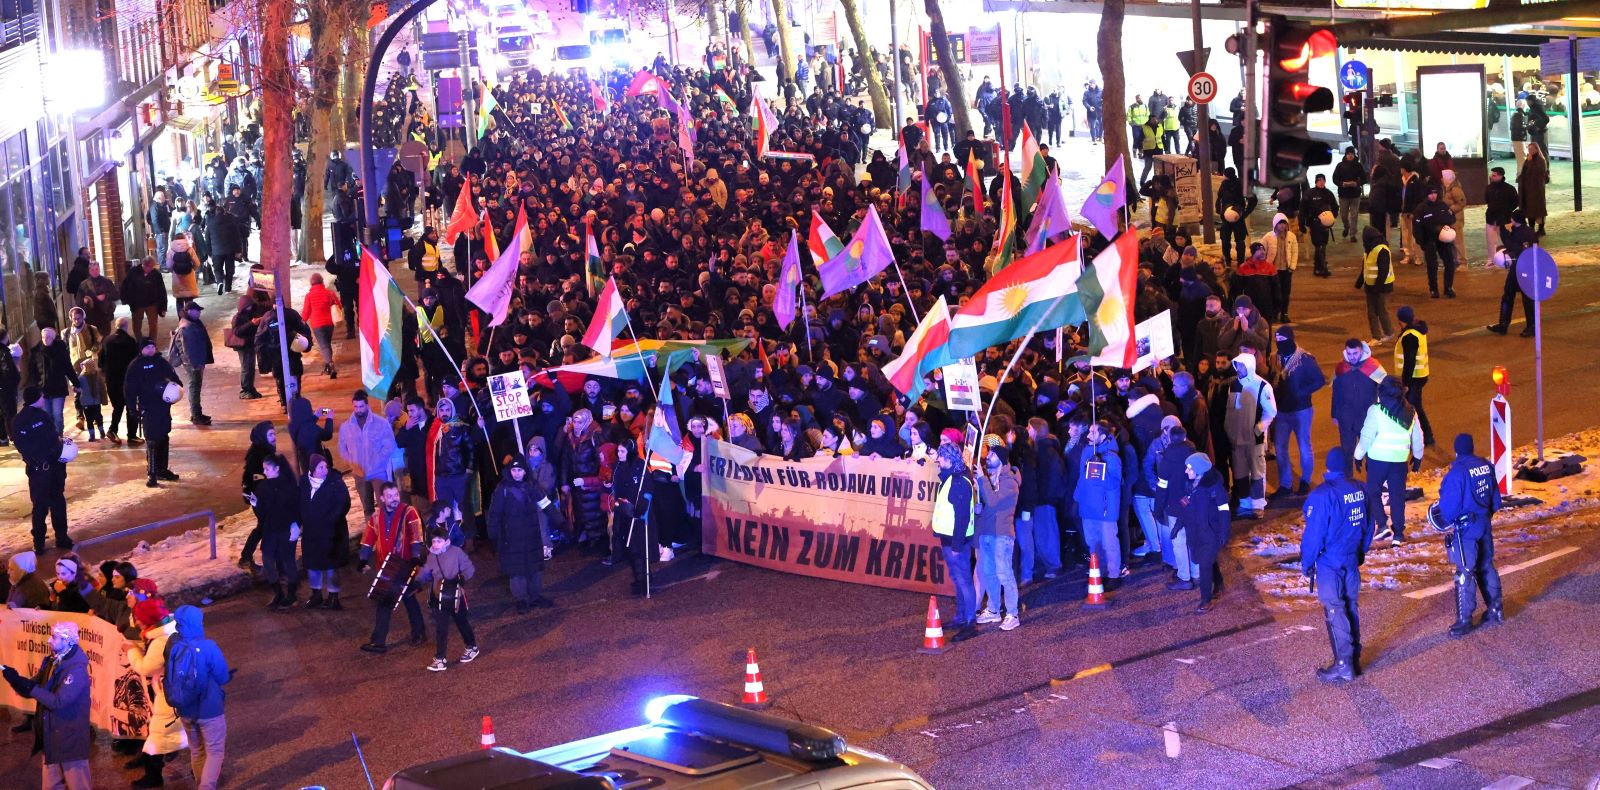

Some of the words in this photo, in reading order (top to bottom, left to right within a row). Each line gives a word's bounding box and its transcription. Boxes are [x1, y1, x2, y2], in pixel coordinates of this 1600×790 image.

[1194, 81, 1211, 95] 30
[496, 392, 521, 406] STOP
[709, 455, 774, 485] FRIEDEN
[778, 466, 811, 489] FÜR
[815, 471, 876, 496] ROJAVA
[881, 476, 913, 500] UND
[1351, 507, 1361, 516] HH
[725, 516, 790, 562] NEIN
[796, 529, 860, 573] ZUM
[865, 538, 945, 585] KRIEG
[21, 619, 52, 636] Türkisch
[79, 628, 104, 649] riffskrieg
[16, 639, 28, 652] und
[28, 639, 51, 655] Dschi
